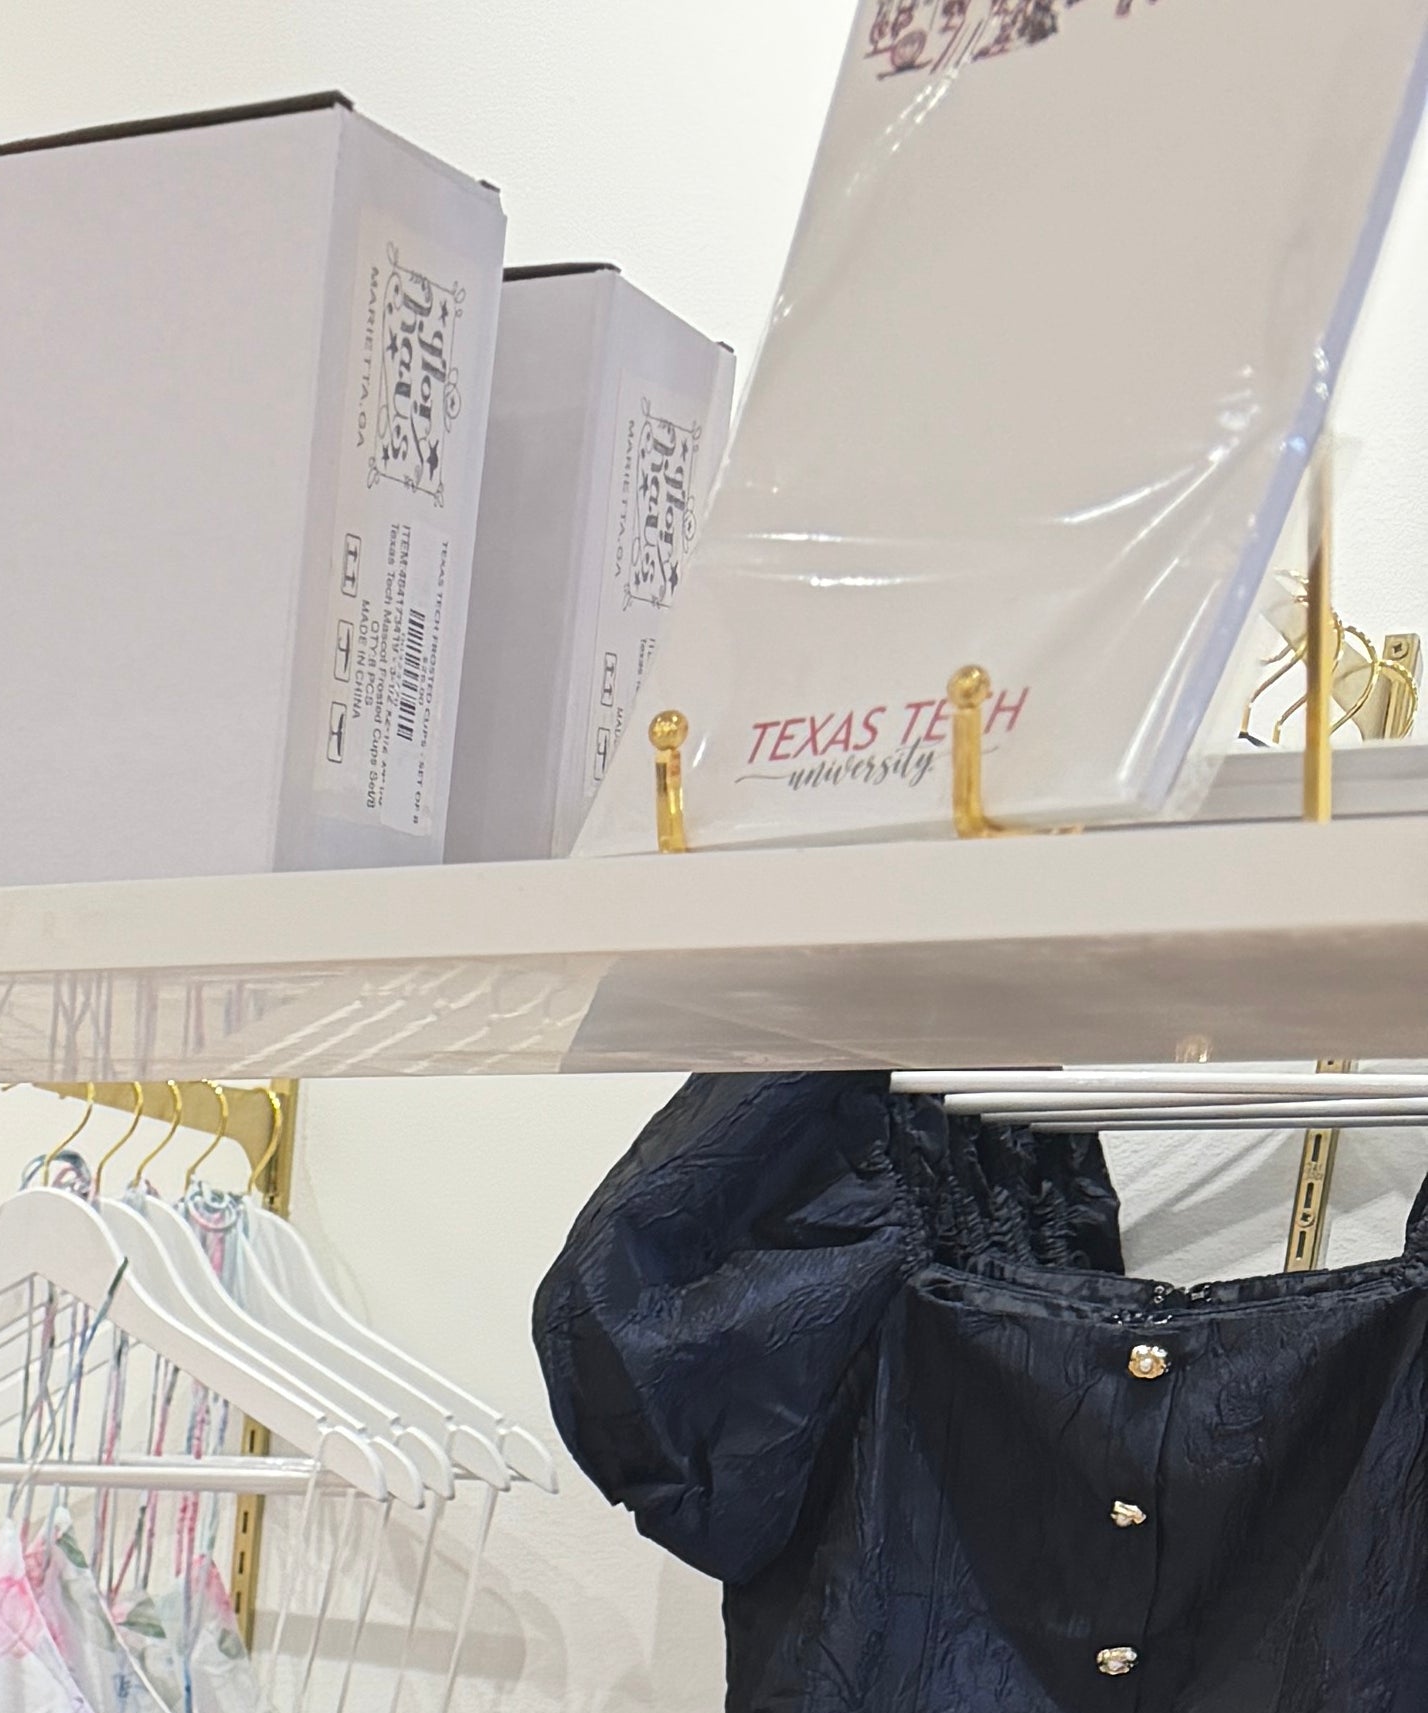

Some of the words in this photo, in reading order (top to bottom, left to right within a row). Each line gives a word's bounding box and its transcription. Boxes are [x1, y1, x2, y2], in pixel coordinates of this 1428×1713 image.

[386, 522, 401, 566] Texas
[436, 541, 450, 587] TEXAS
[382, 572, 397, 606] Tech
[432, 592, 444, 632] TECH
[356, 600, 372, 647] MADE
[377, 609, 393, 664] Mascot
[424, 635, 440, 704] FROSTED
[351, 670, 367, 720] CHINA
[372, 667, 388, 723] Frosted
[369, 727, 383, 765] Cups
[419, 707, 432, 748] CUPS
[747, 704, 888, 765] TEXAS
[900, 685, 1031, 746] TEH
[743, 736, 940, 791] university
